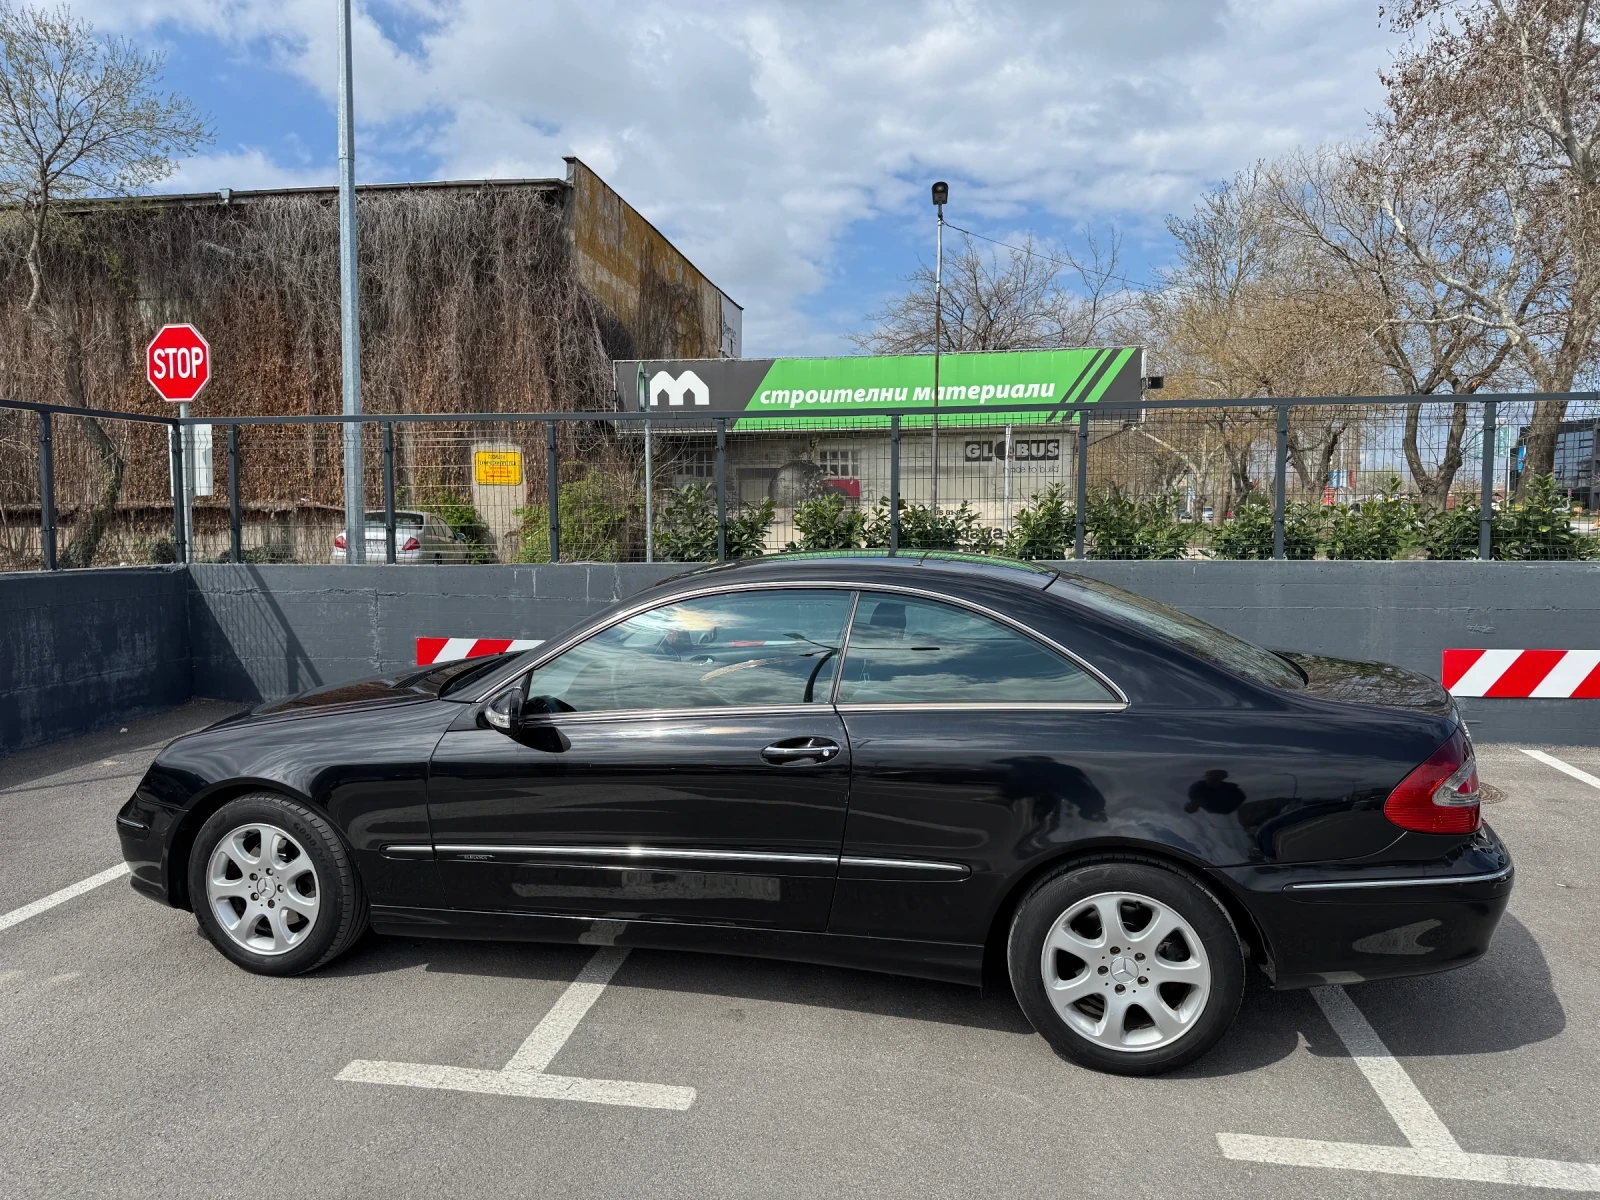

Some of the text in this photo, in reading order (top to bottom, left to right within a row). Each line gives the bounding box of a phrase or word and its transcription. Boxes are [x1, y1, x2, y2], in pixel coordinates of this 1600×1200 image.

[153, 346, 204, 380] STOP
[759, 383, 1056, 409] строителни материали
